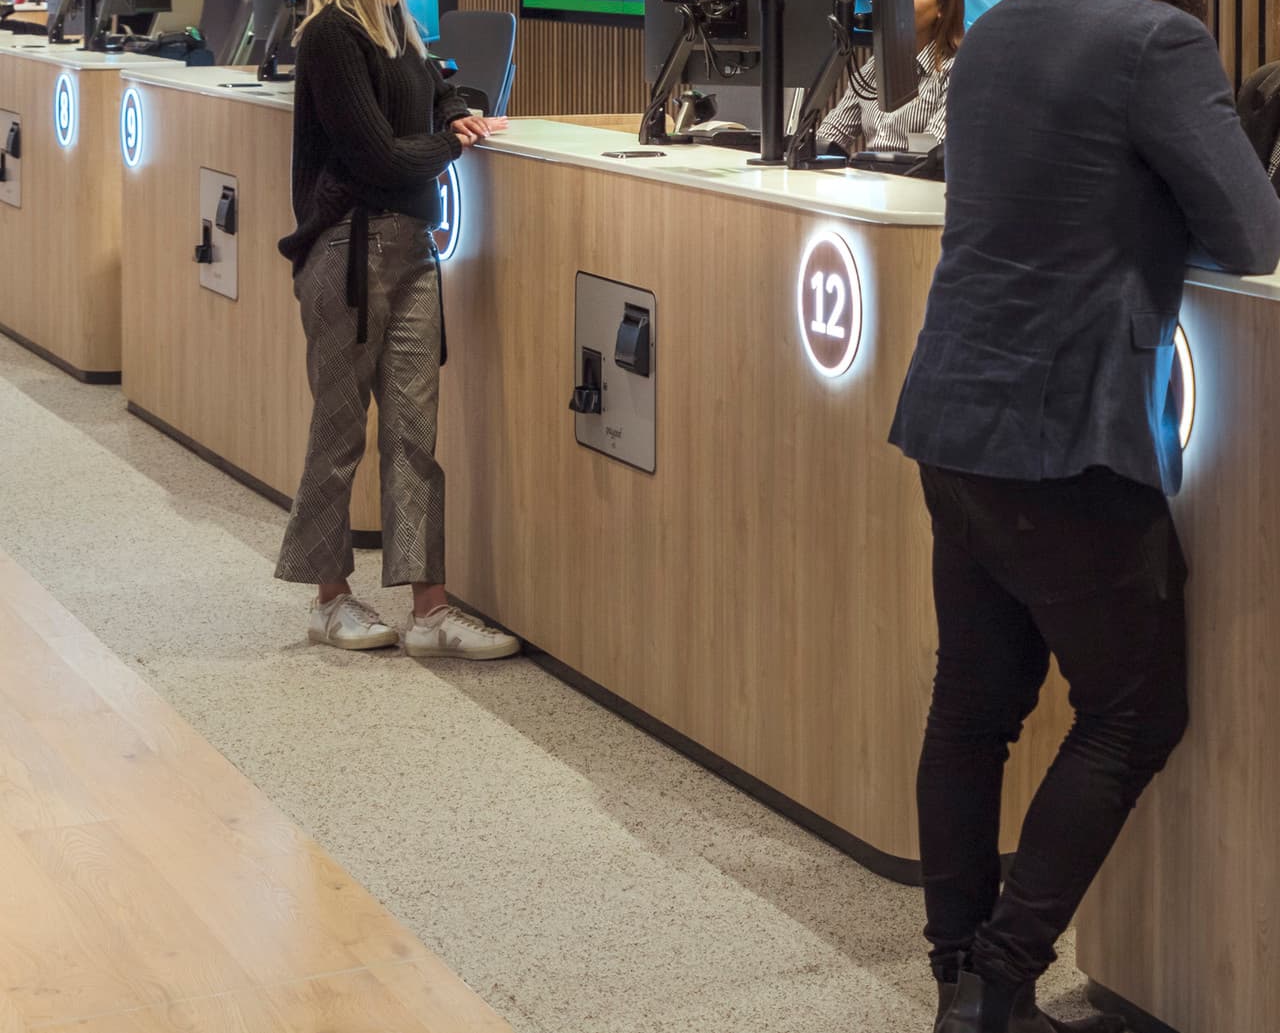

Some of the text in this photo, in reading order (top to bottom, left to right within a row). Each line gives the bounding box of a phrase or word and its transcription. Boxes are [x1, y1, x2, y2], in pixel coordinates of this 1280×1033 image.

[60, 91, 69, 129] 8
[127, 107, 136, 148] 9
[440, 184, 450, 231] 1
[811, 271, 846, 339] 12
